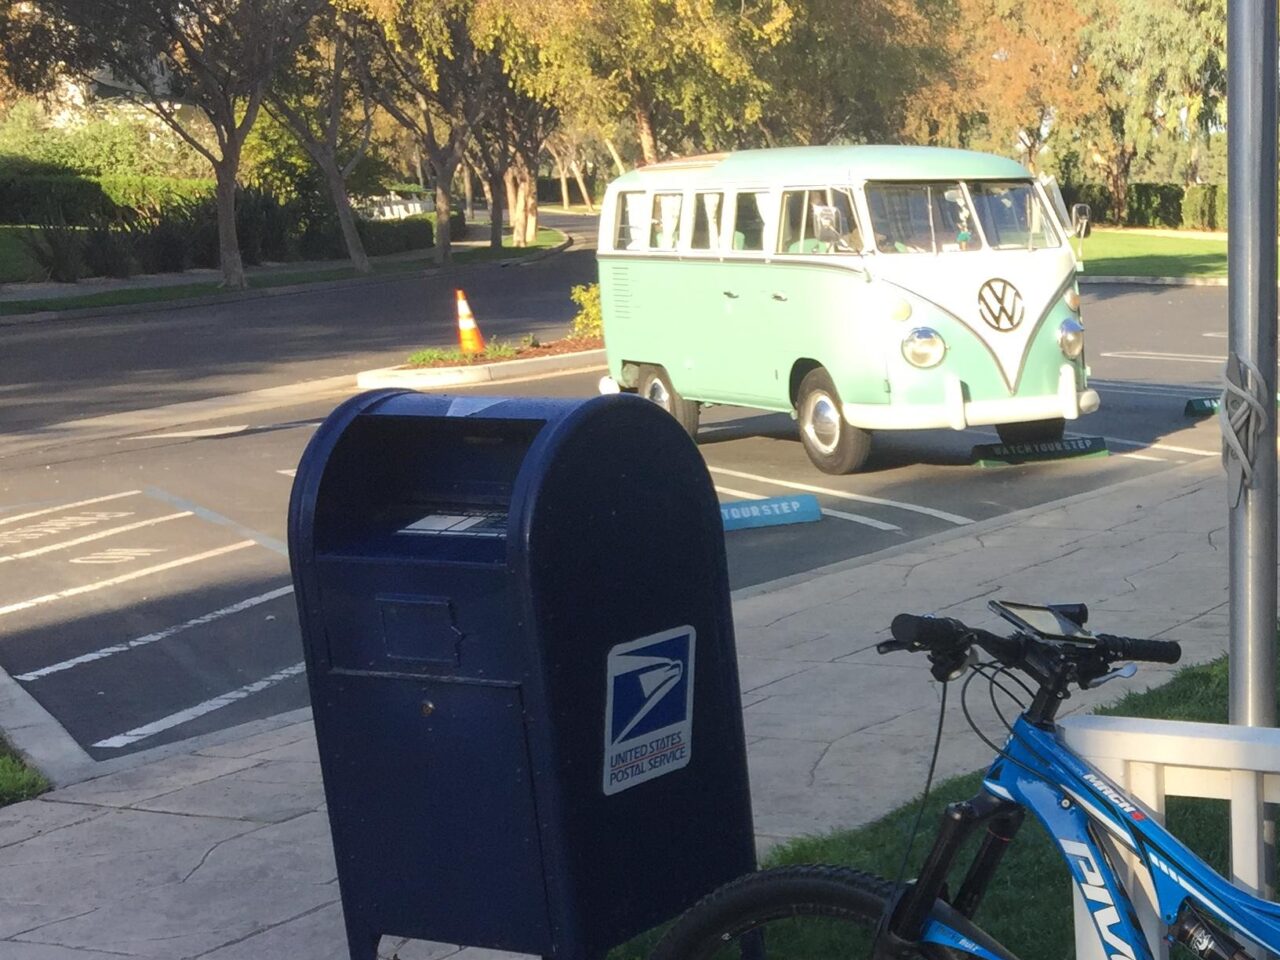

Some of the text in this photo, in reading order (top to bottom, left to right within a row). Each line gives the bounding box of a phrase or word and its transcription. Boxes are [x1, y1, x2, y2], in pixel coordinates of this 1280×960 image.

[978, 278, 1024, 332] VW
[1063, 439, 1092, 450] STEP
[761, 501, 800, 515] STEP
[609, 746, 687, 786] POSTAL SERVICE
[610, 731, 682, 769] UNITED STATES
[1083, 774, 1136, 812] MACH
